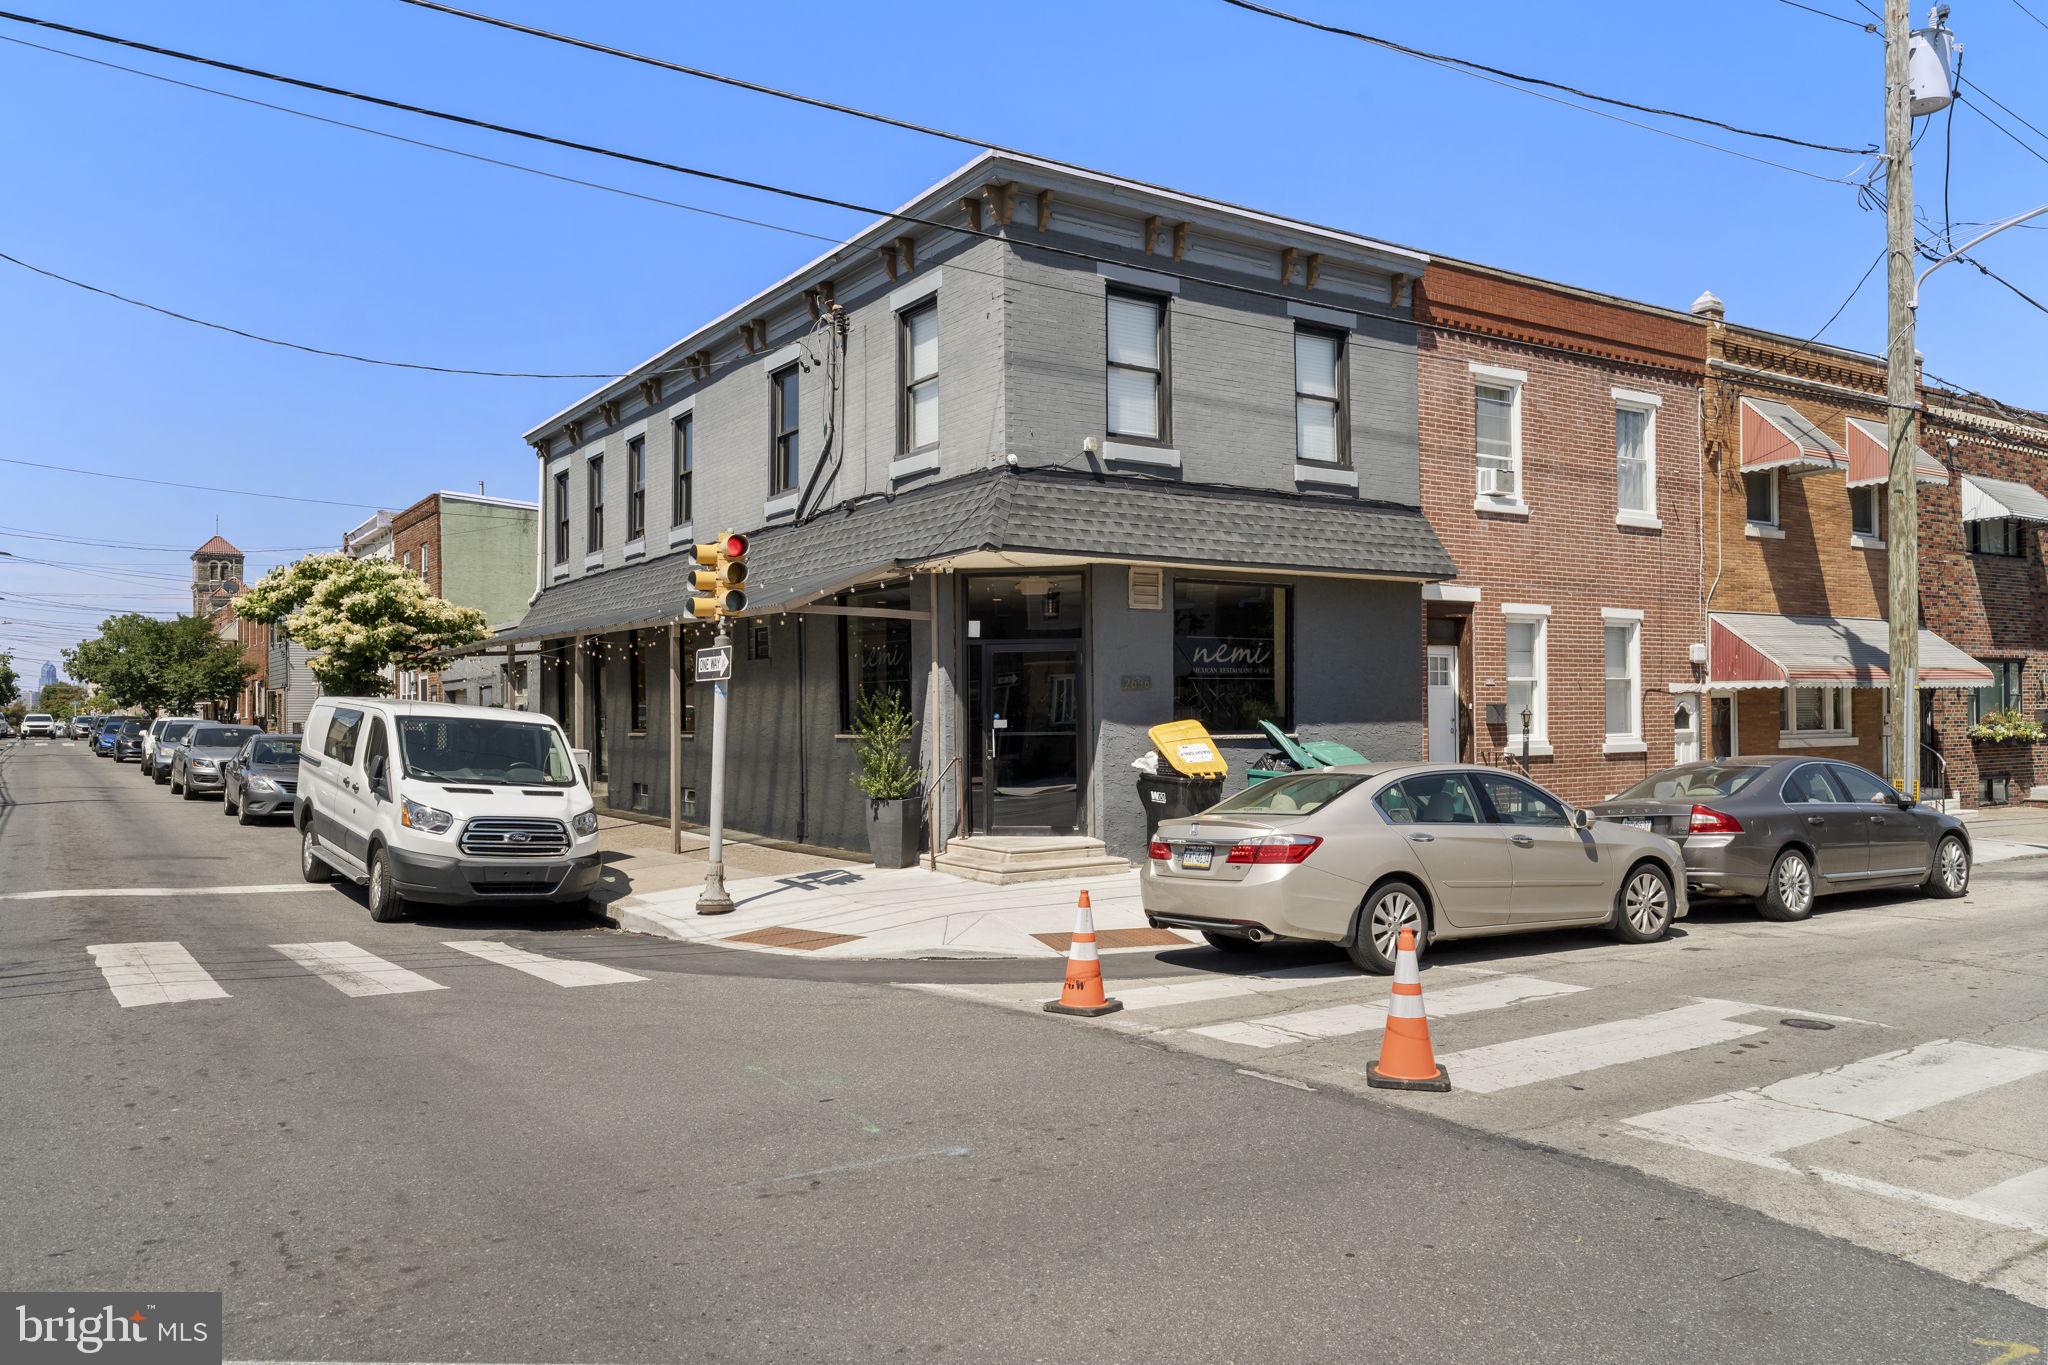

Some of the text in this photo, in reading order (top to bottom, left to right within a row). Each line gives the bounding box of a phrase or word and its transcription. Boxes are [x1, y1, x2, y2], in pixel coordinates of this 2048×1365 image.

[1192, 642, 1271, 664] nemi
[699, 657, 721, 671] ONE WAY
